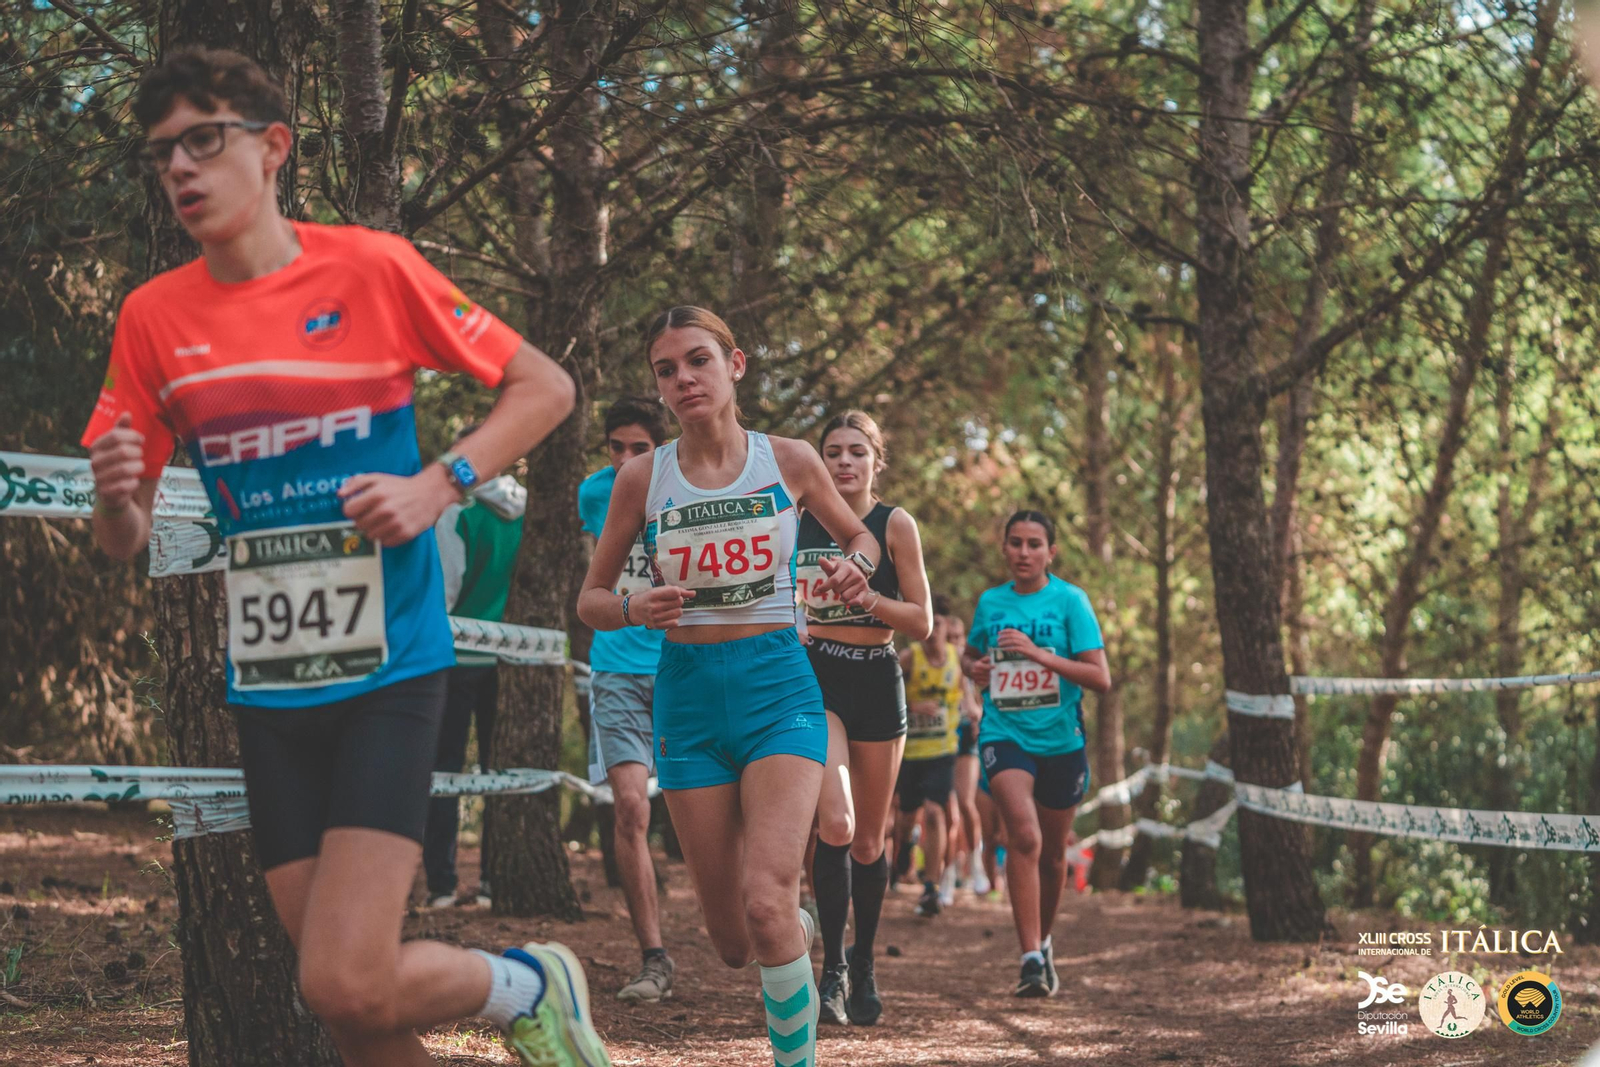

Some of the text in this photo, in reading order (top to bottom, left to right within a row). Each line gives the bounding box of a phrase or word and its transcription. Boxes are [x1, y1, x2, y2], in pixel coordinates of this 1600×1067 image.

[199, 405, 373, 468] CAPA
[240, 473, 352, 509] Los Alcor
[687, 501, 745, 520] ITÁLICA
[668, 534, 773, 581] 7485
[241, 583, 369, 647] 5947
[819, 642, 897, 660] NIKE PR
[997, 668, 1055, 692] 7492
